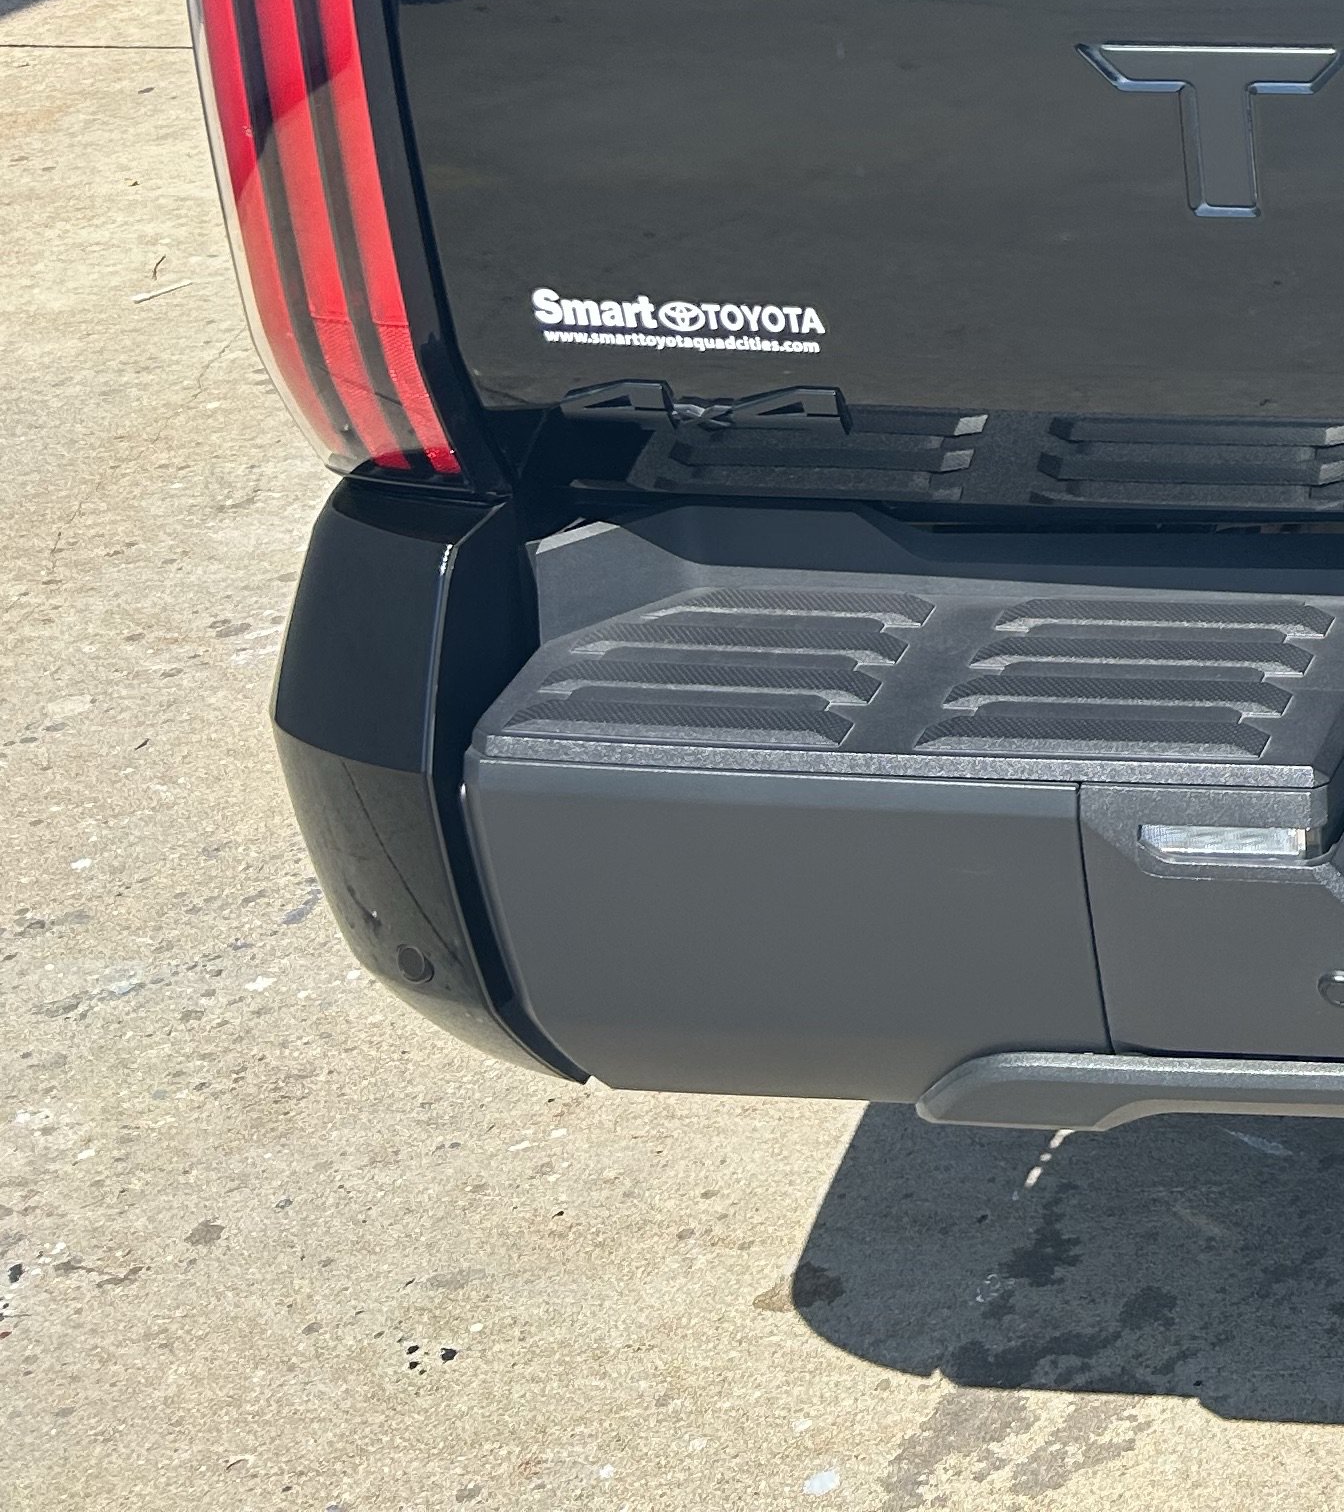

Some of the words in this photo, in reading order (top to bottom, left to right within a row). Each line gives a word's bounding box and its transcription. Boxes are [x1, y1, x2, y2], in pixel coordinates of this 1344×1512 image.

[532, 288, 657, 329] Smart
[702, 303, 826, 334] TOYOTA
[543, 330, 821, 354] www.smarttoyotaquadcities.com
